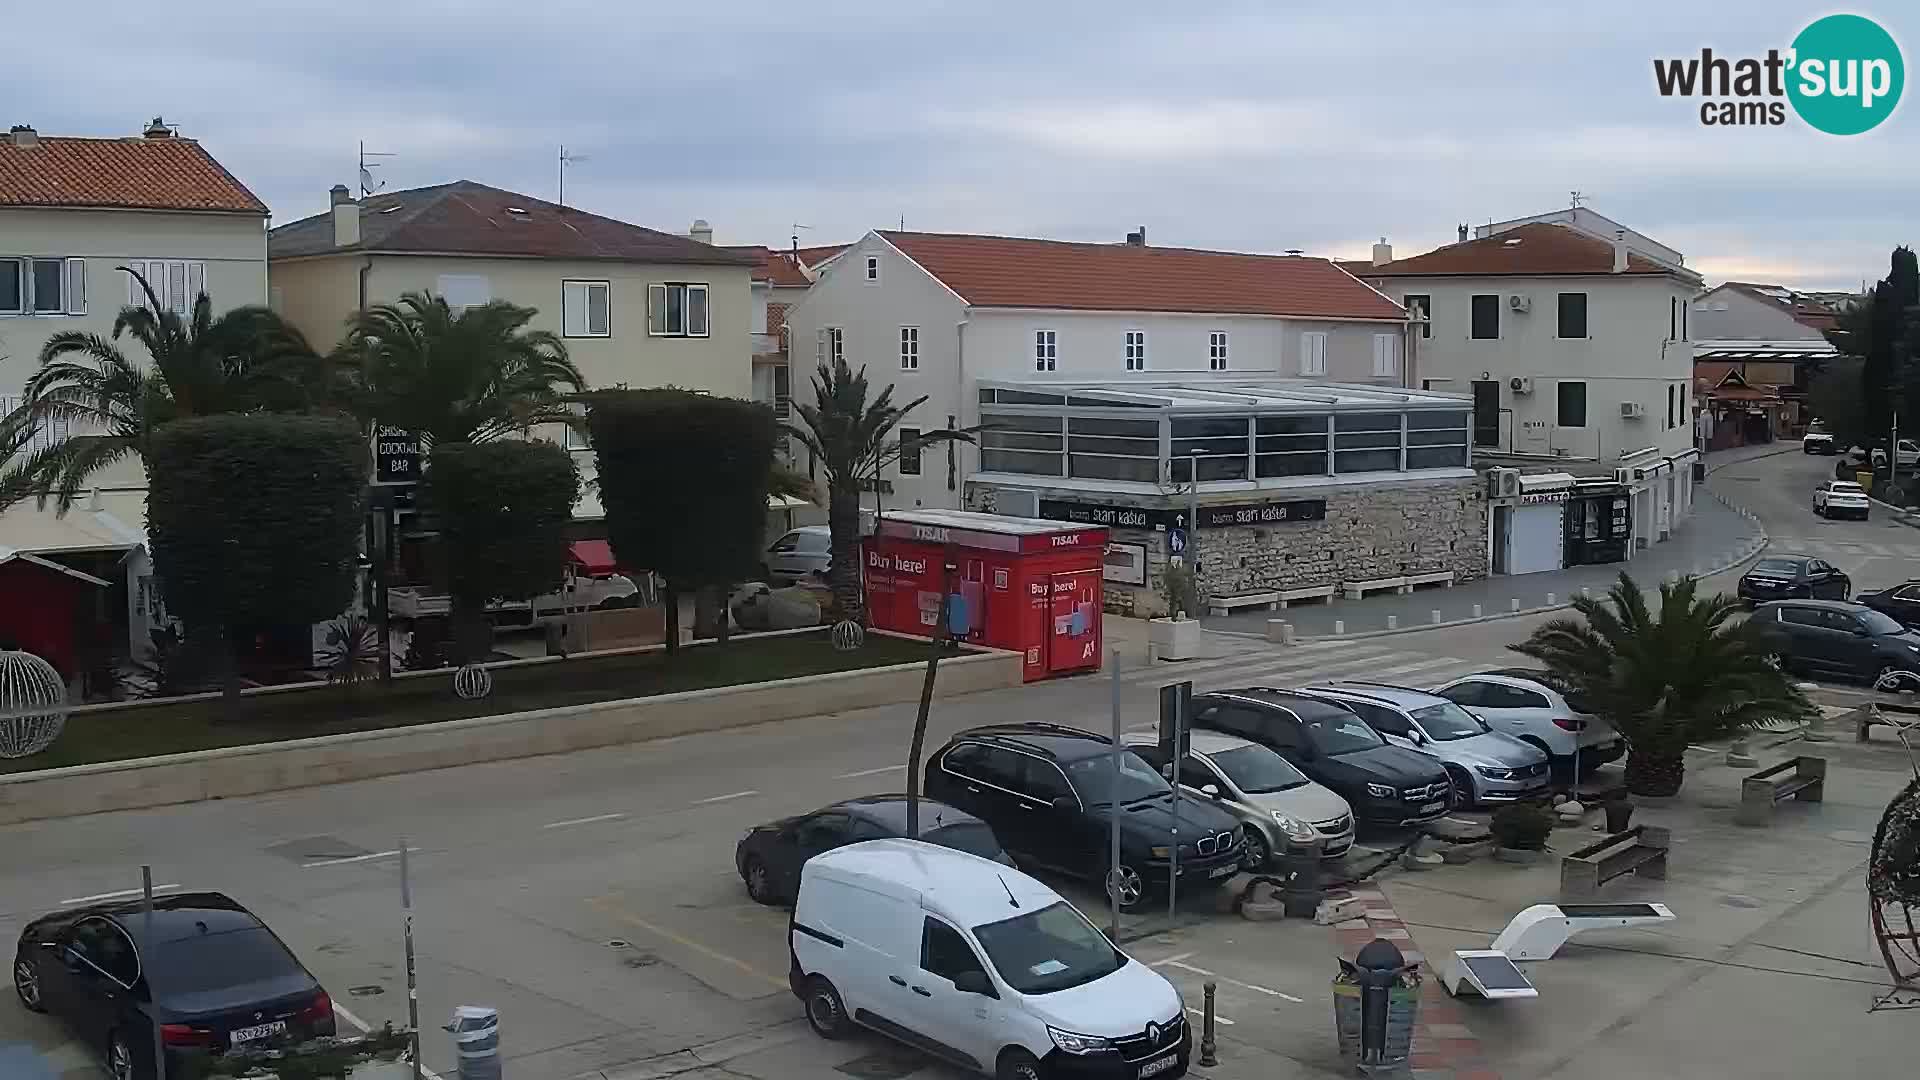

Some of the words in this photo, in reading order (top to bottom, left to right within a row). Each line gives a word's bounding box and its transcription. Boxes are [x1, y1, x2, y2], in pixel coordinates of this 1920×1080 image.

[391, 460, 409, 472] BAR
[1523, 493, 1562, 504] MARKET
[1051, 535, 1080, 546] TISAK
[895, 554, 926, 575] here!
[1031, 583, 1049, 595] Buy
[1054, 579, 1077, 593] here!
[1082, 640, 1095, 659] A1
